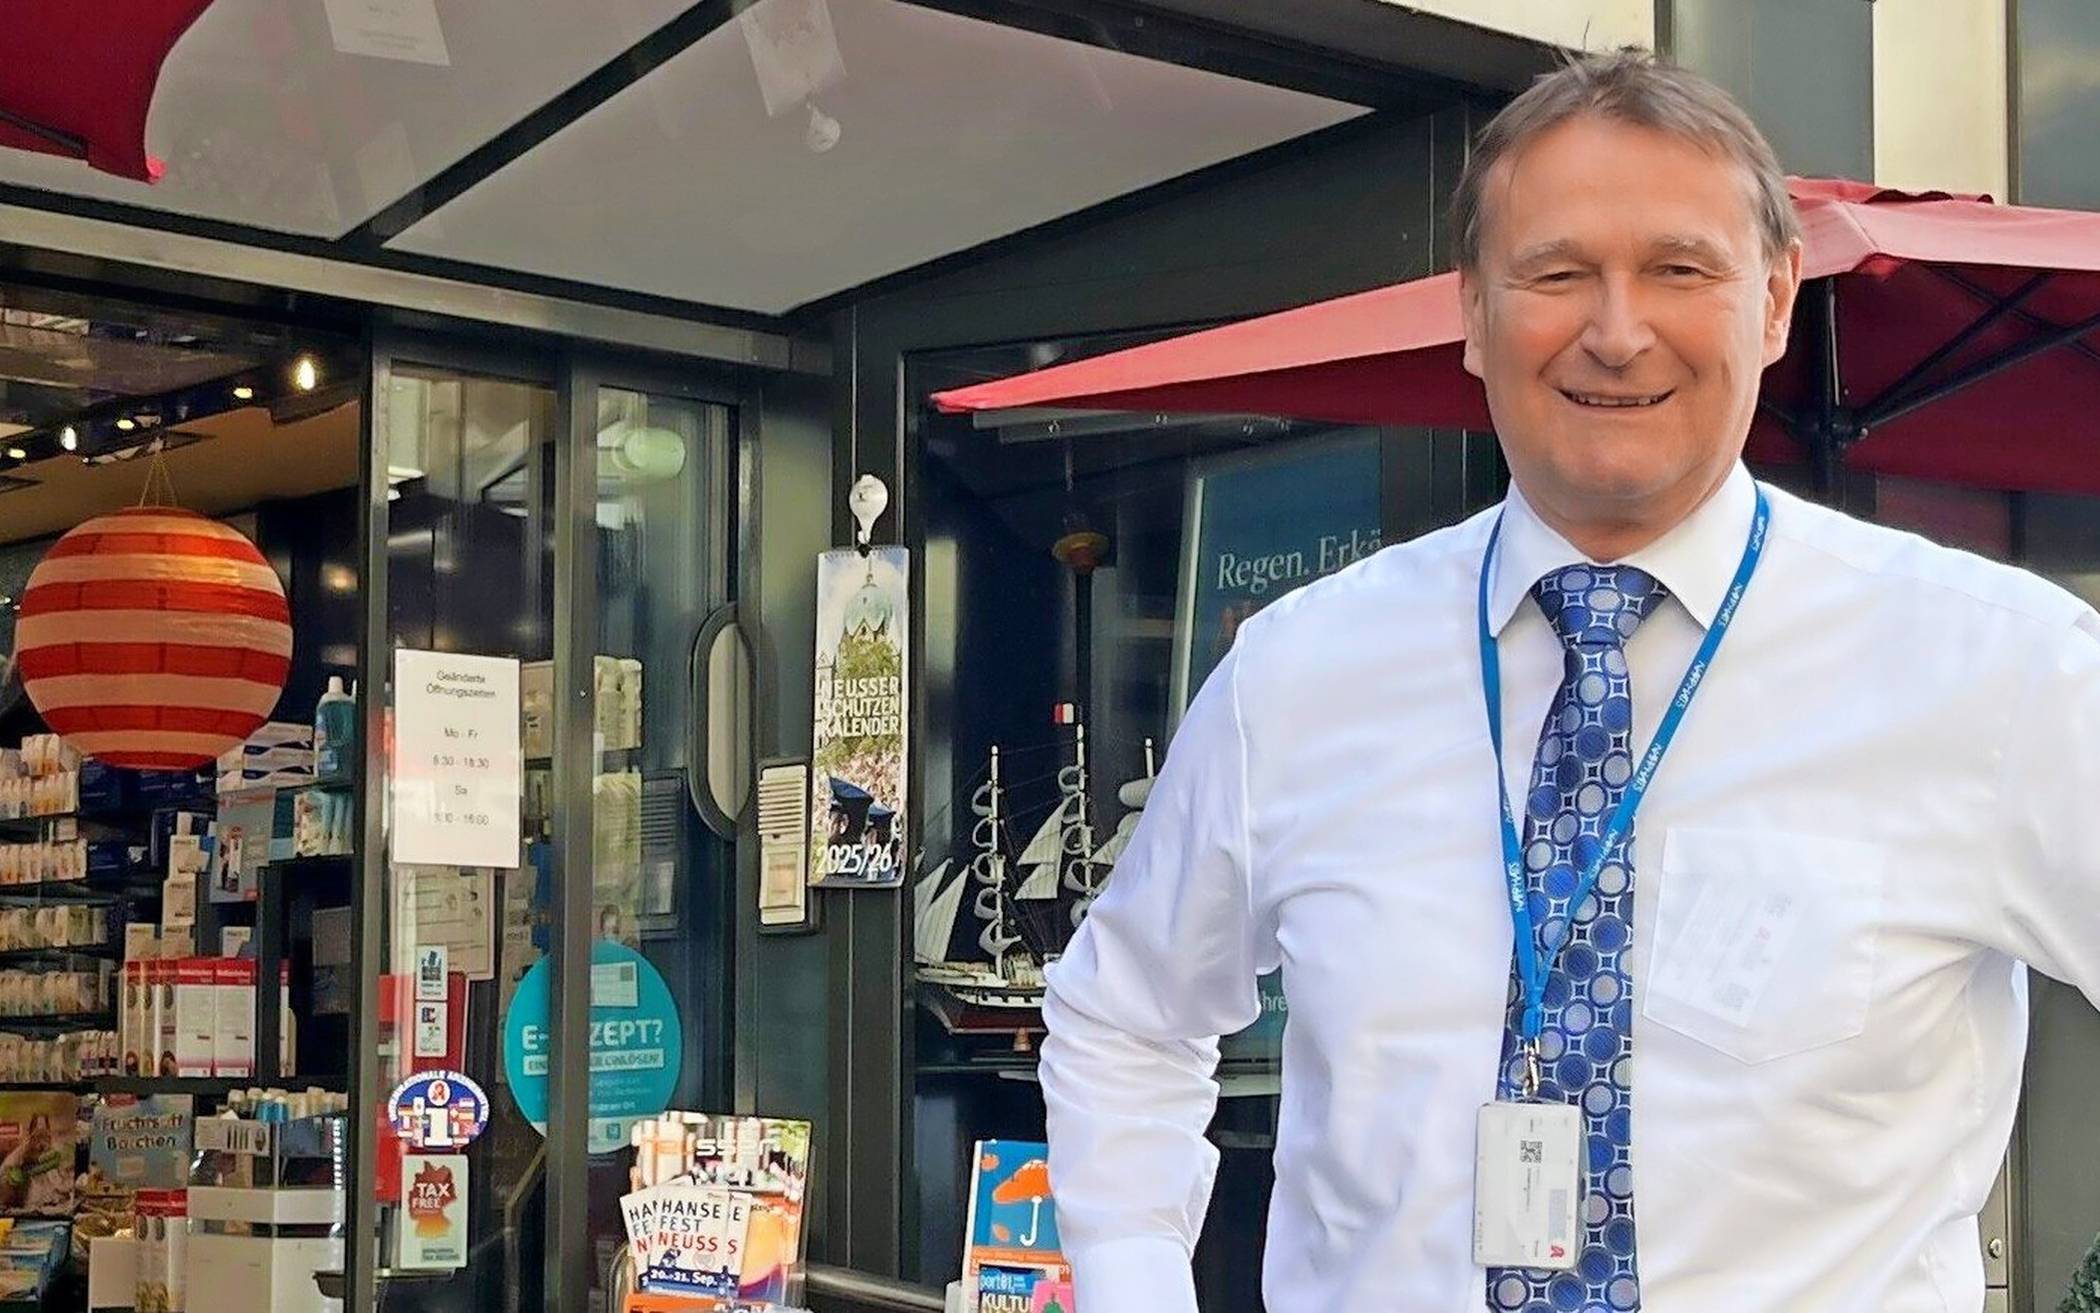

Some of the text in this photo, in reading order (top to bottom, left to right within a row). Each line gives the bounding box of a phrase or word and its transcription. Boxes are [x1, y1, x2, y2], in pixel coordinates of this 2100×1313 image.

[1217, 550, 1310, 594] Regen.
[819, 714, 899, 739] KALENDER
[816, 843, 892, 877] 2025/26
[102, 1113, 184, 1131] Fruchtsft
[106, 1136, 176, 1150] Bchen
[416, 1183, 451, 1198] TAX
[662, 1198, 721, 1220] HANSE
[659, 1216, 702, 1233] FEST
[658, 1232, 719, 1253] NEUSS
